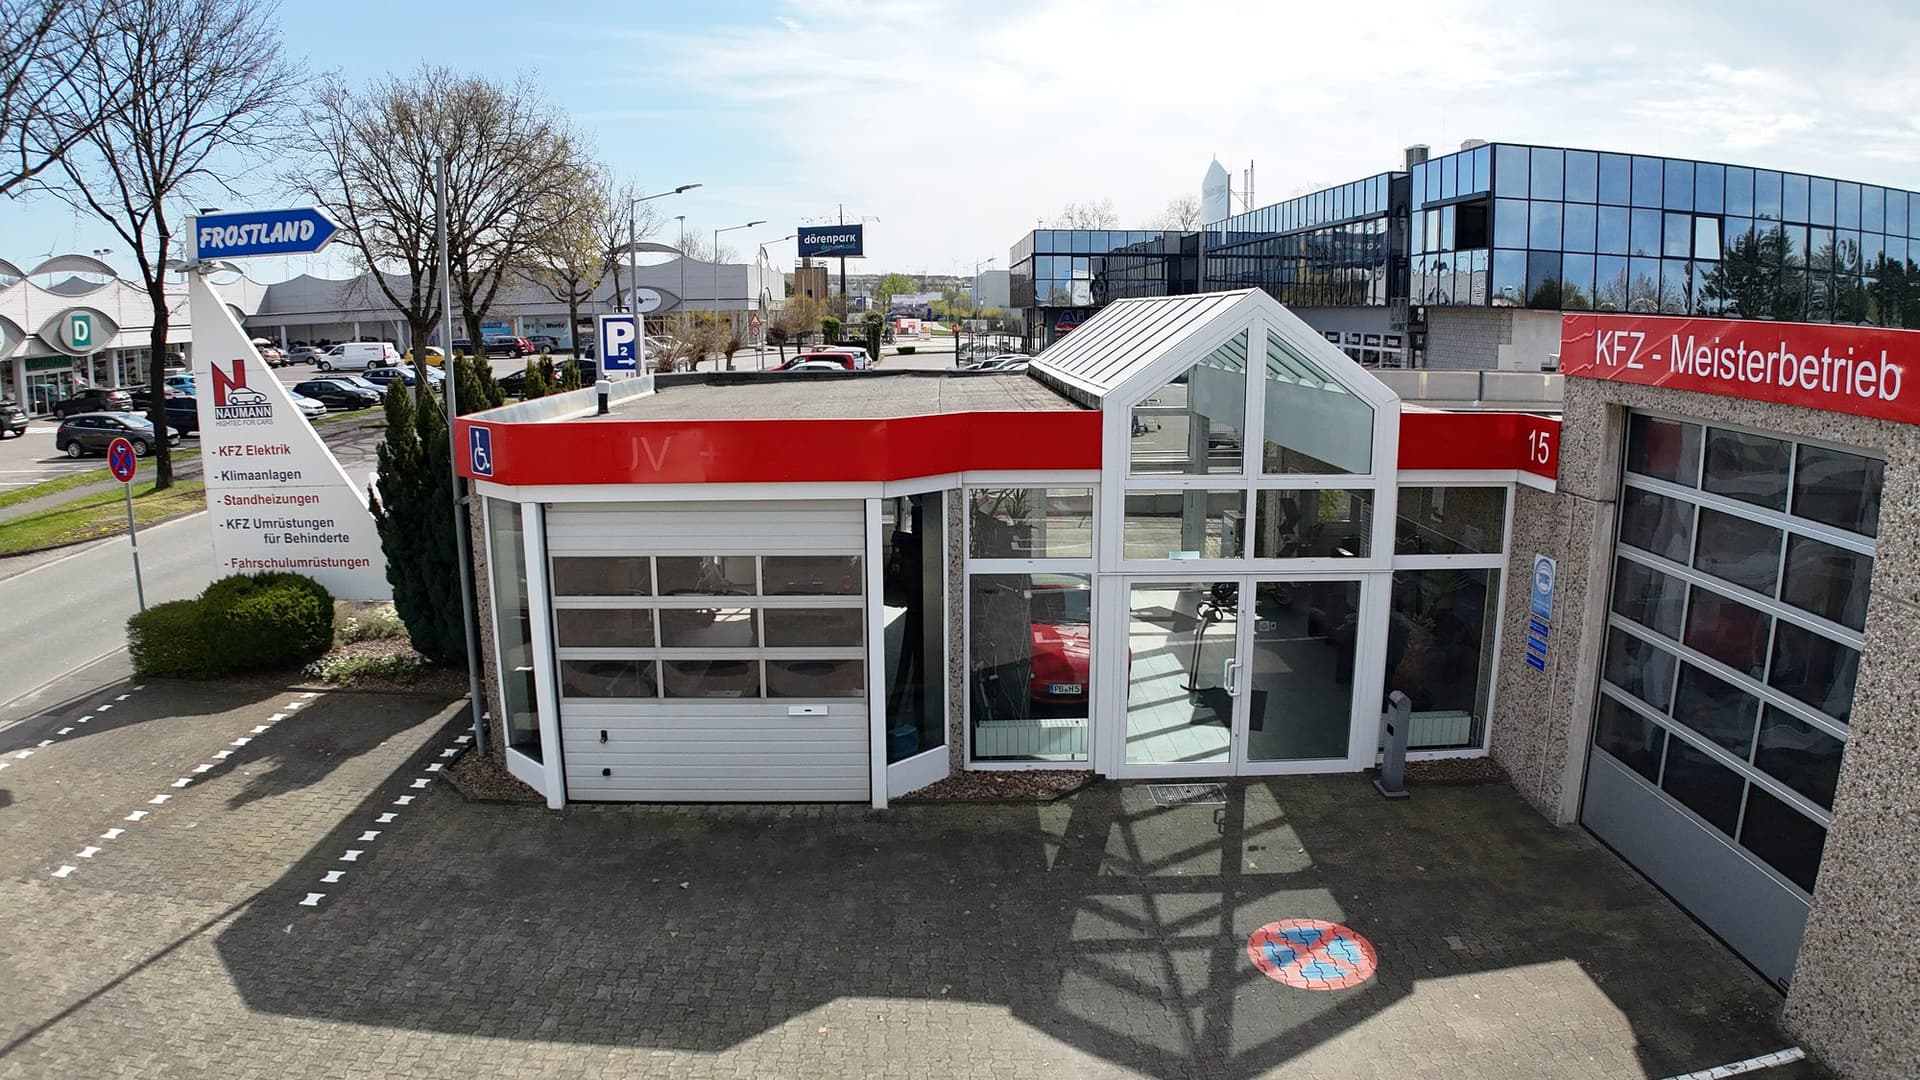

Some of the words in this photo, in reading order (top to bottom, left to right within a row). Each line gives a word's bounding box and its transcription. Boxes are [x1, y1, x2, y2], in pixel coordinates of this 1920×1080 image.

[200, 219, 315, 249] FROSTLAND
[804, 233, 856, 244] dörenpark
[74, 320, 88, 341] D
[606, 321, 635, 356] P
[620, 346, 628, 356] 2
[1596, 329, 1645, 369] KFZ
[1670, 334, 1901, 401] Meisterbetrieb
[215, 406, 272, 419] NAUMANN
[219, 446, 243, 456] KFZ
[246, 444, 291, 455] Elektrik
[1528, 429, 1550, 464] 15
[221, 470, 301, 482] Klimaanlagen
[224, 494, 319, 506] Standheizungen
[226, 519, 250, 529] KFZ
[253, 517, 334, 530] Umrüstungen
[264, 533, 281, 544] für
[284, 533, 349, 543] Behinderte
[231, 557, 369, 569] Fahrschulumrüstungen
